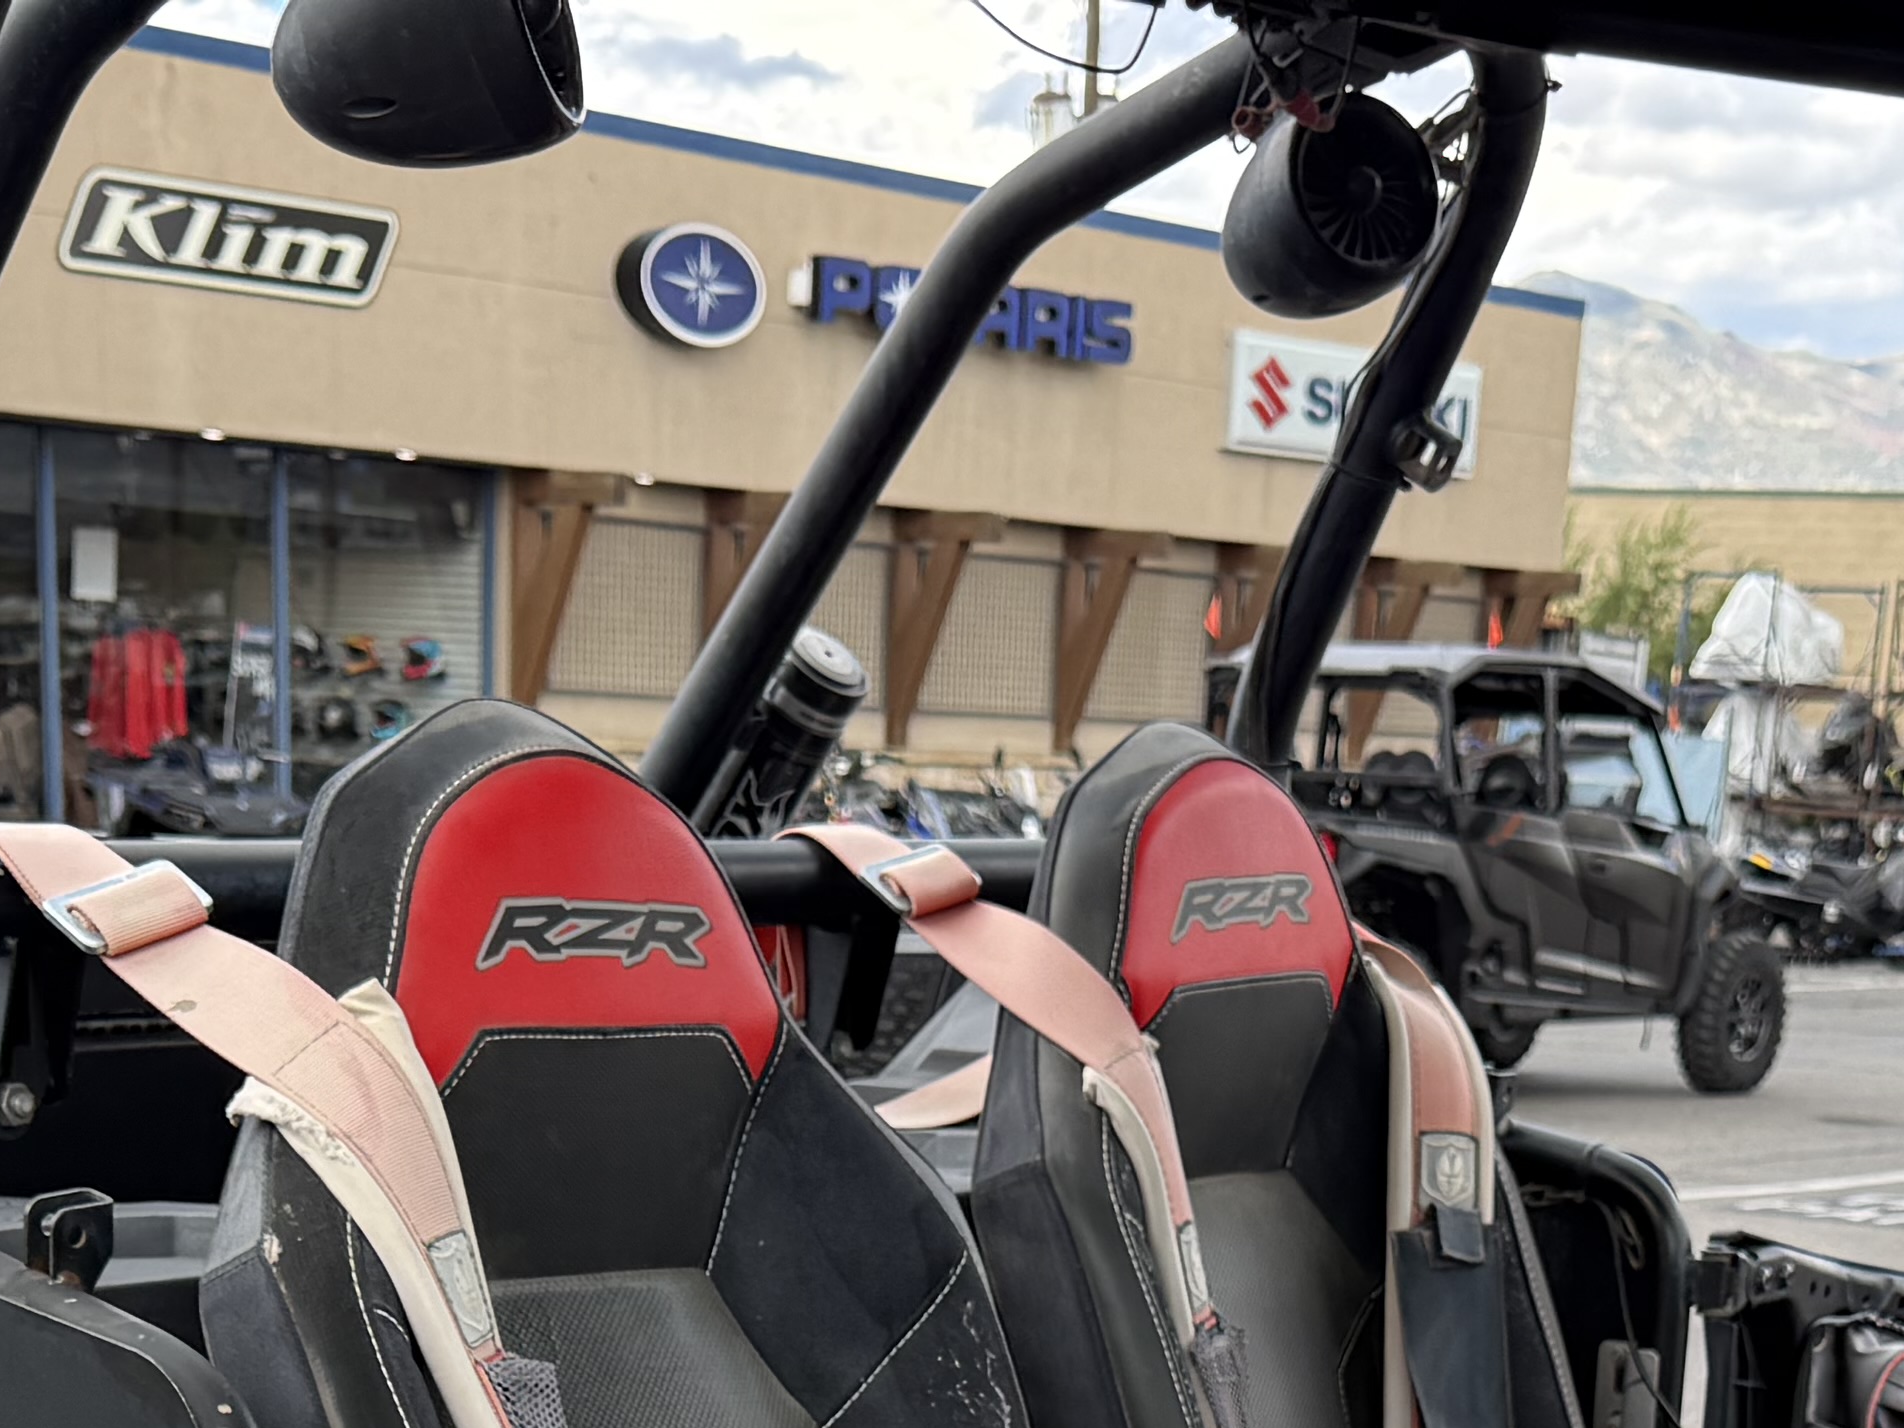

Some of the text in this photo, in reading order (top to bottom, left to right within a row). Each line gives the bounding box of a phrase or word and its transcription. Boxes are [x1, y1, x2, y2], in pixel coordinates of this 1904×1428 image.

[818, 255, 1132, 366] POARIS
[475, 897, 713, 971] RZR
[1170, 872, 1313, 945] RZR
